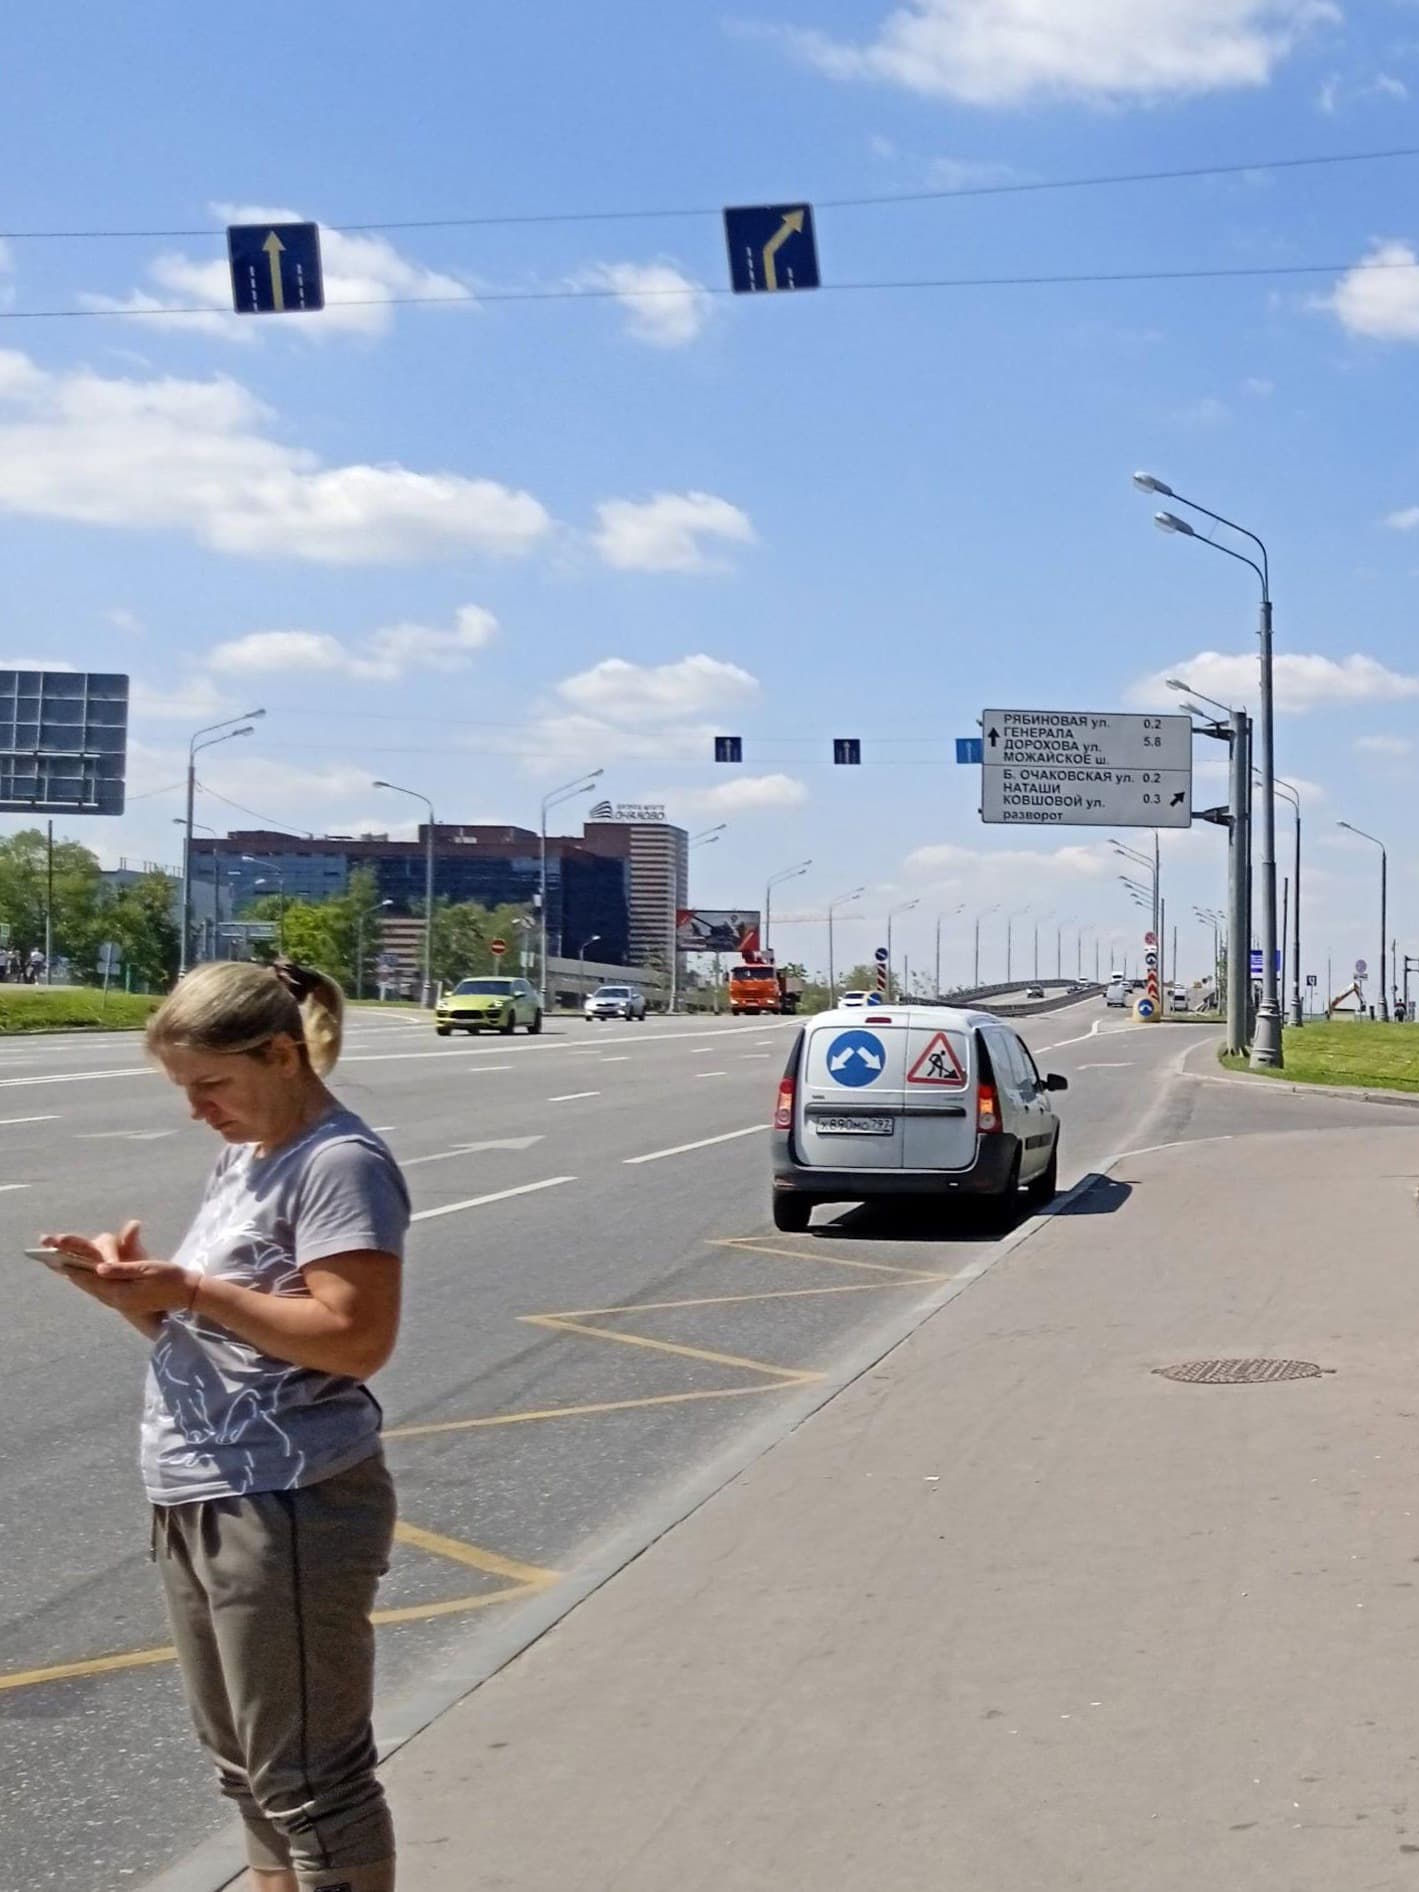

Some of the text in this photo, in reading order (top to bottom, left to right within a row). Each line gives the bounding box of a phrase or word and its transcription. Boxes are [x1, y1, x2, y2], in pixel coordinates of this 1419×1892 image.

[1003, 713, 1162, 730] РЯБИНОВАЯ ул. 0.2
[1003, 726, 1074, 738] ГЕНЕРАЛА
[1003, 739, 1080, 751] ДОРОХОВА
[1083, 744, 1102, 754] ул.
[1003, 751, 1091, 765] МОЖАЙСКОЕ
[1003, 769, 1161, 785] Б. ОЧАКОВСКАЯ ул. 0.2
[1003, 783, 1061, 794] НАТАШИ
[1003, 793, 1161, 809] КОВШОВОЙ ул. 0.3
[1003, 810, 1064, 822] разворот
